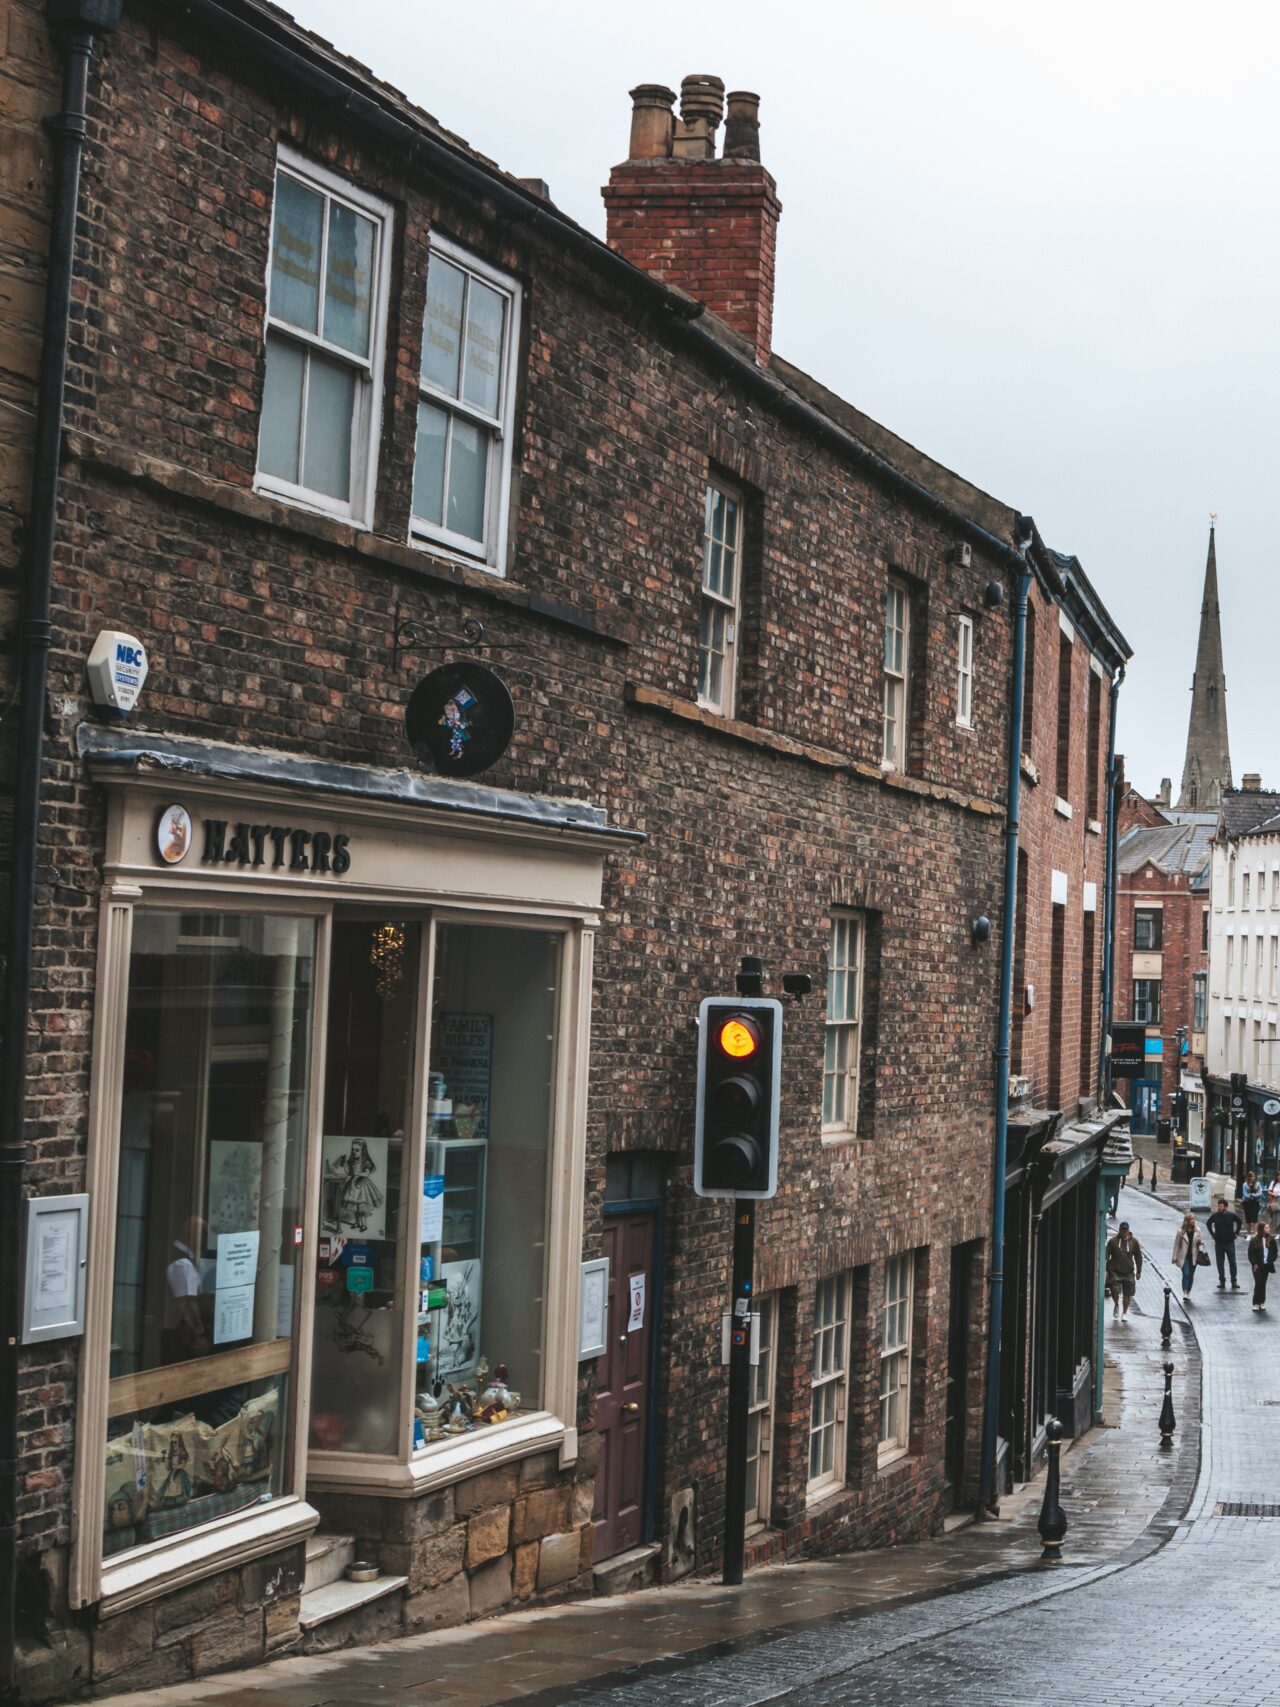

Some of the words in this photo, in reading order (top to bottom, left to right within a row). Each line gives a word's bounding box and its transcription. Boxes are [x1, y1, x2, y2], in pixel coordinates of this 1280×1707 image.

[116, 644, 142, 667] NBC
[116, 664, 139, 675] SECURITY
[116, 673, 138, 685] SYSTEMS
[201, 819, 351, 874] HATTERS
[442, 1018, 489, 1033] FAMILY
[445, 1033, 485, 1047] RULES
